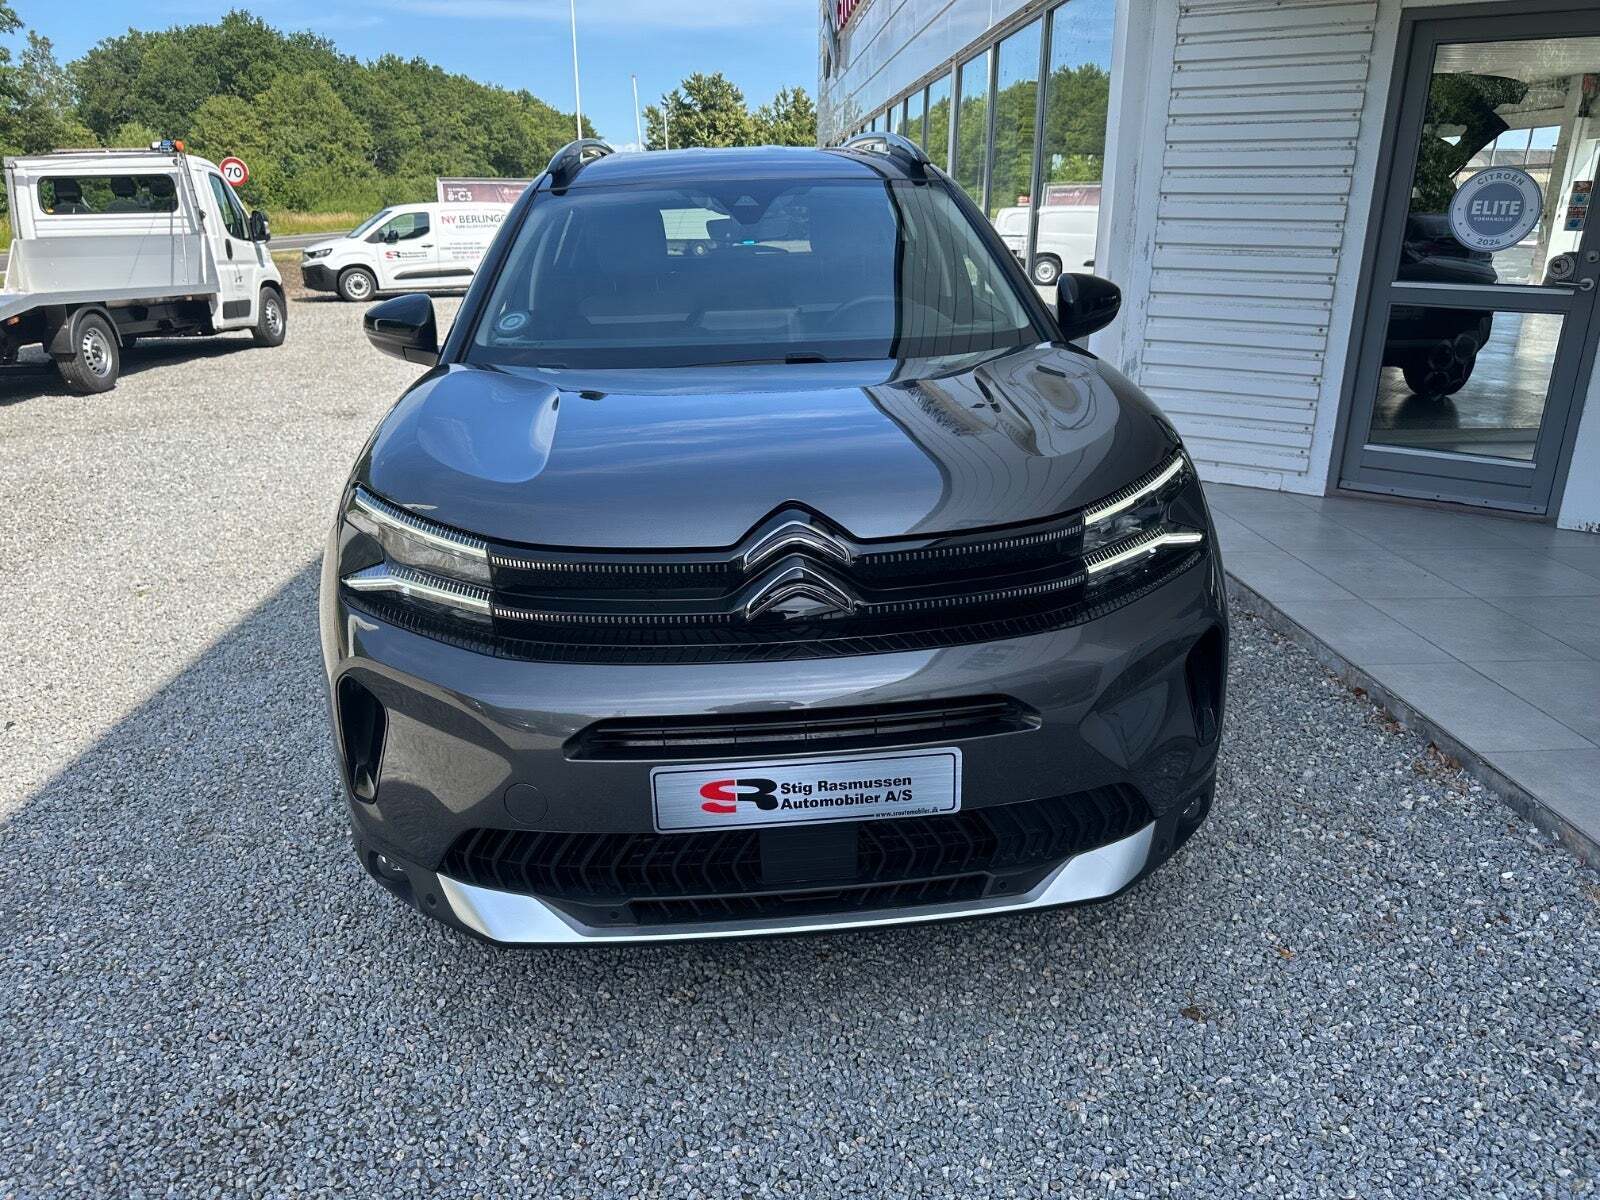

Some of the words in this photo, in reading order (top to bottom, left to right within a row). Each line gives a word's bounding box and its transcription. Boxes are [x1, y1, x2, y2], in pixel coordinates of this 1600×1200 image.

[226, 167, 242, 178] 70
[1471, 200, 1521, 215] ELITE
[441, 215, 457, 225] NY
[1476, 238, 1501, 246] 2024
[781, 782, 813, 796] Stig
[817, 777, 912, 792] Rasmussen
[781, 793, 881, 810] Automobiler
[885, 789, 913, 803] A/S
